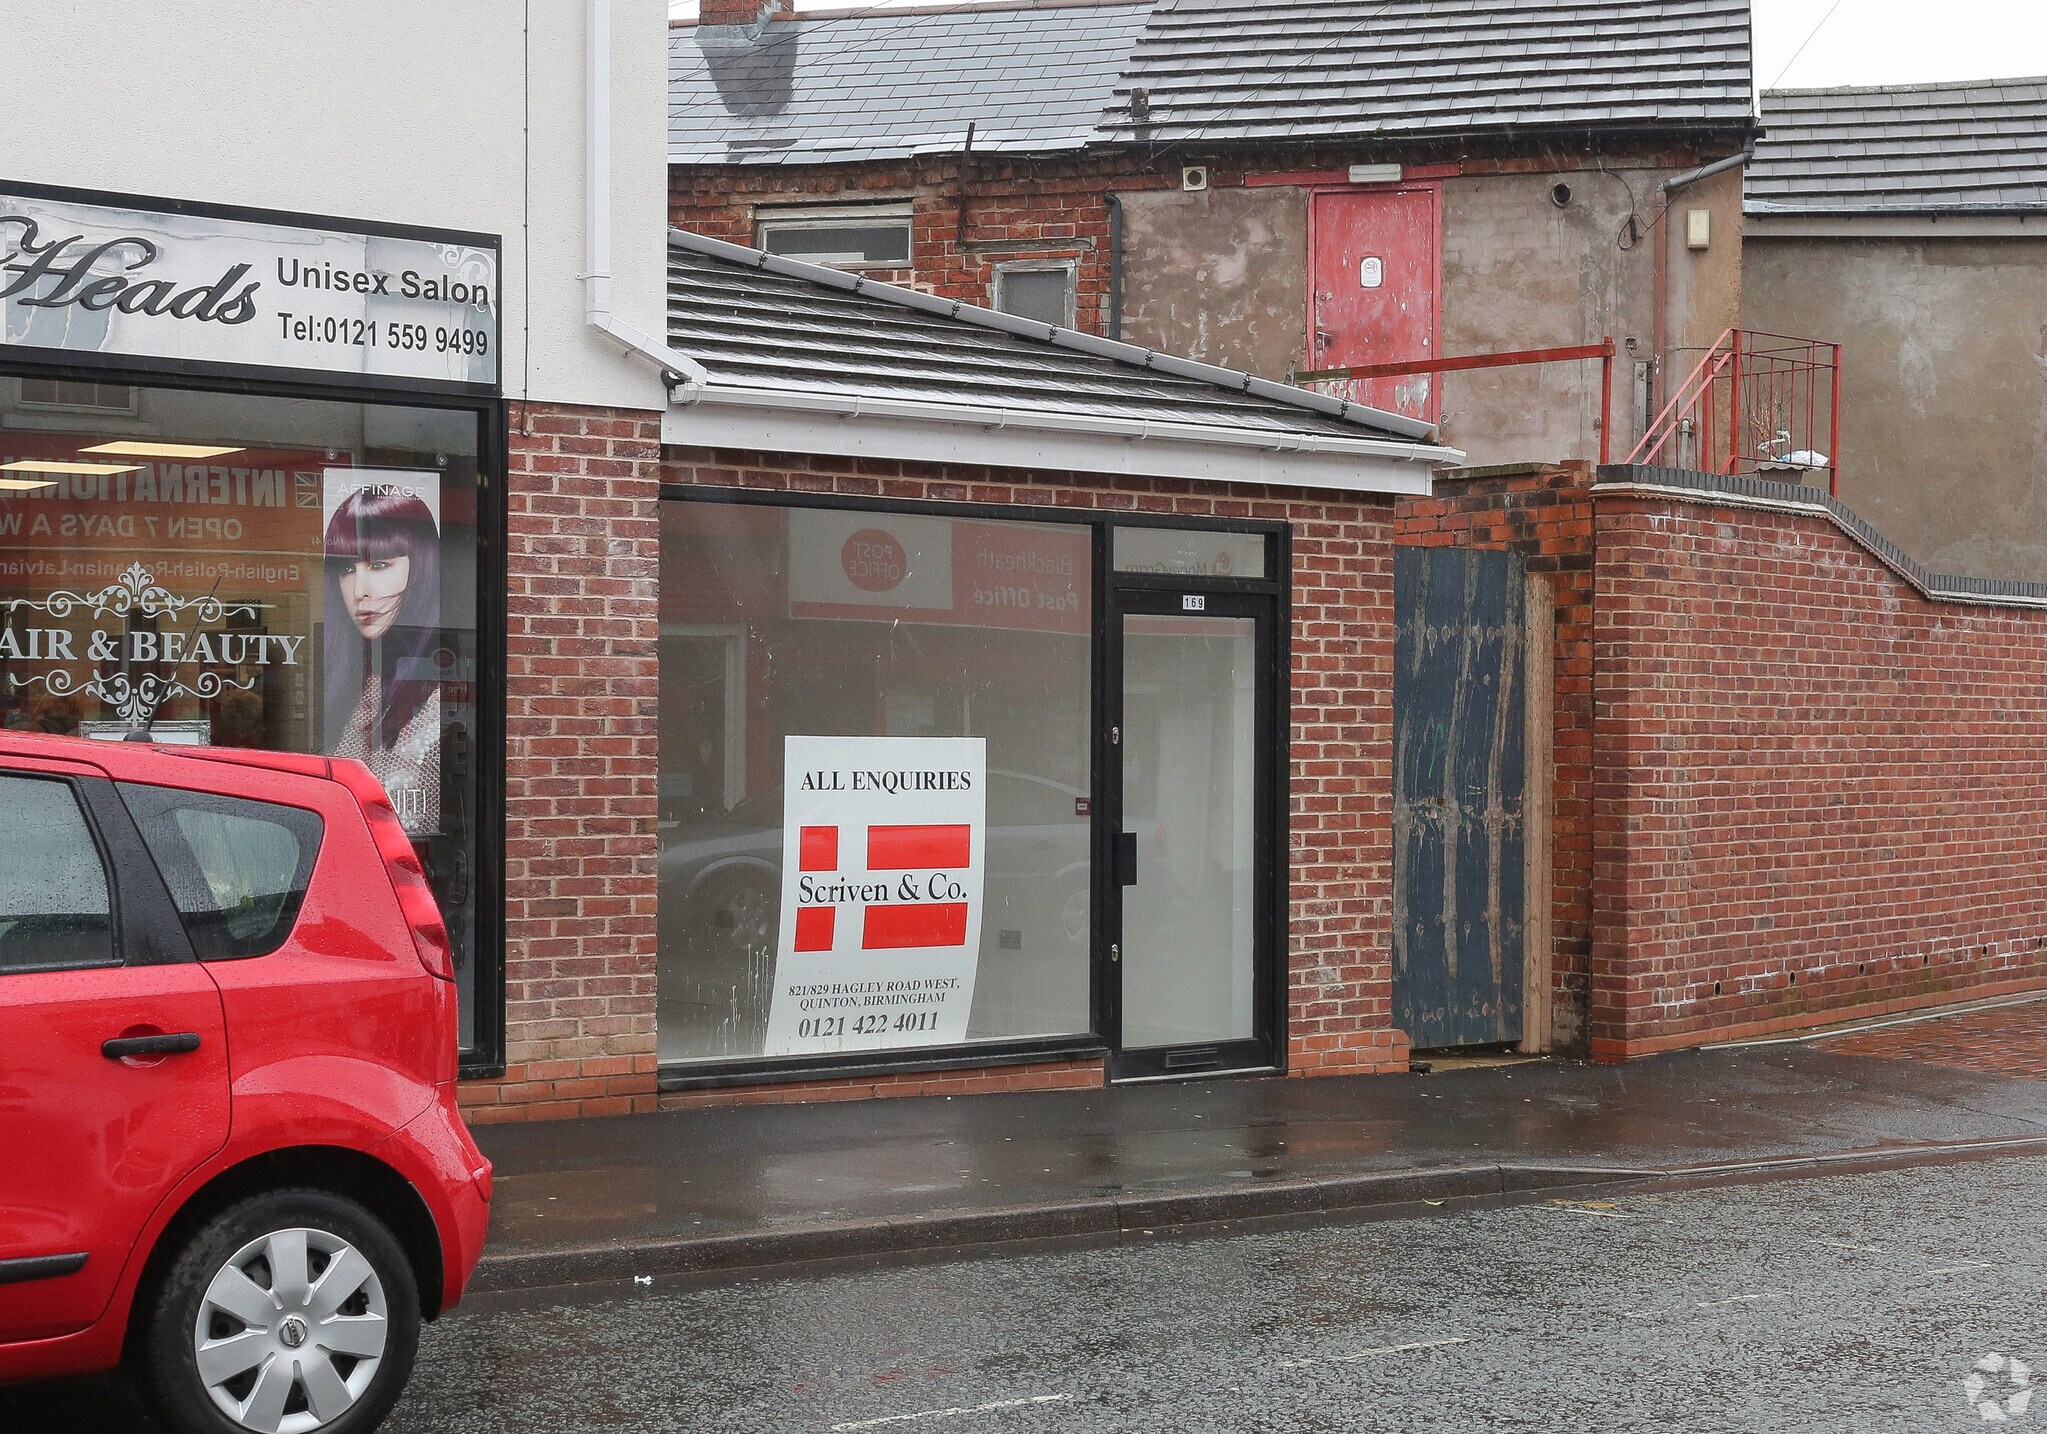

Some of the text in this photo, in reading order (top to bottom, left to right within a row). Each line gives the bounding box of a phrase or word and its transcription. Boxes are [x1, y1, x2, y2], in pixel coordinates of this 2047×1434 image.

[0, 216, 261, 324] Heads
[277, 257, 489, 306] Unisex Salon
[277, 312, 488, 356] Tel:0121 559 9499
[337, 483, 426, 497] AFFINAGE
[1184, 597, 1205, 610] 169
[0, 627, 306, 667] AIR & BEAUTY
[800, 770, 972, 795] ALL ENQUIRIES
[798, 872, 968, 904] Scriven & Co.
[788, 977, 961, 997] 821/829 HAGLEY ROAD WEST,
[799, 992, 946, 1011] QUINTON, BIRMINGHAM
[798, 1011, 938, 1038] 0121 422 4011
